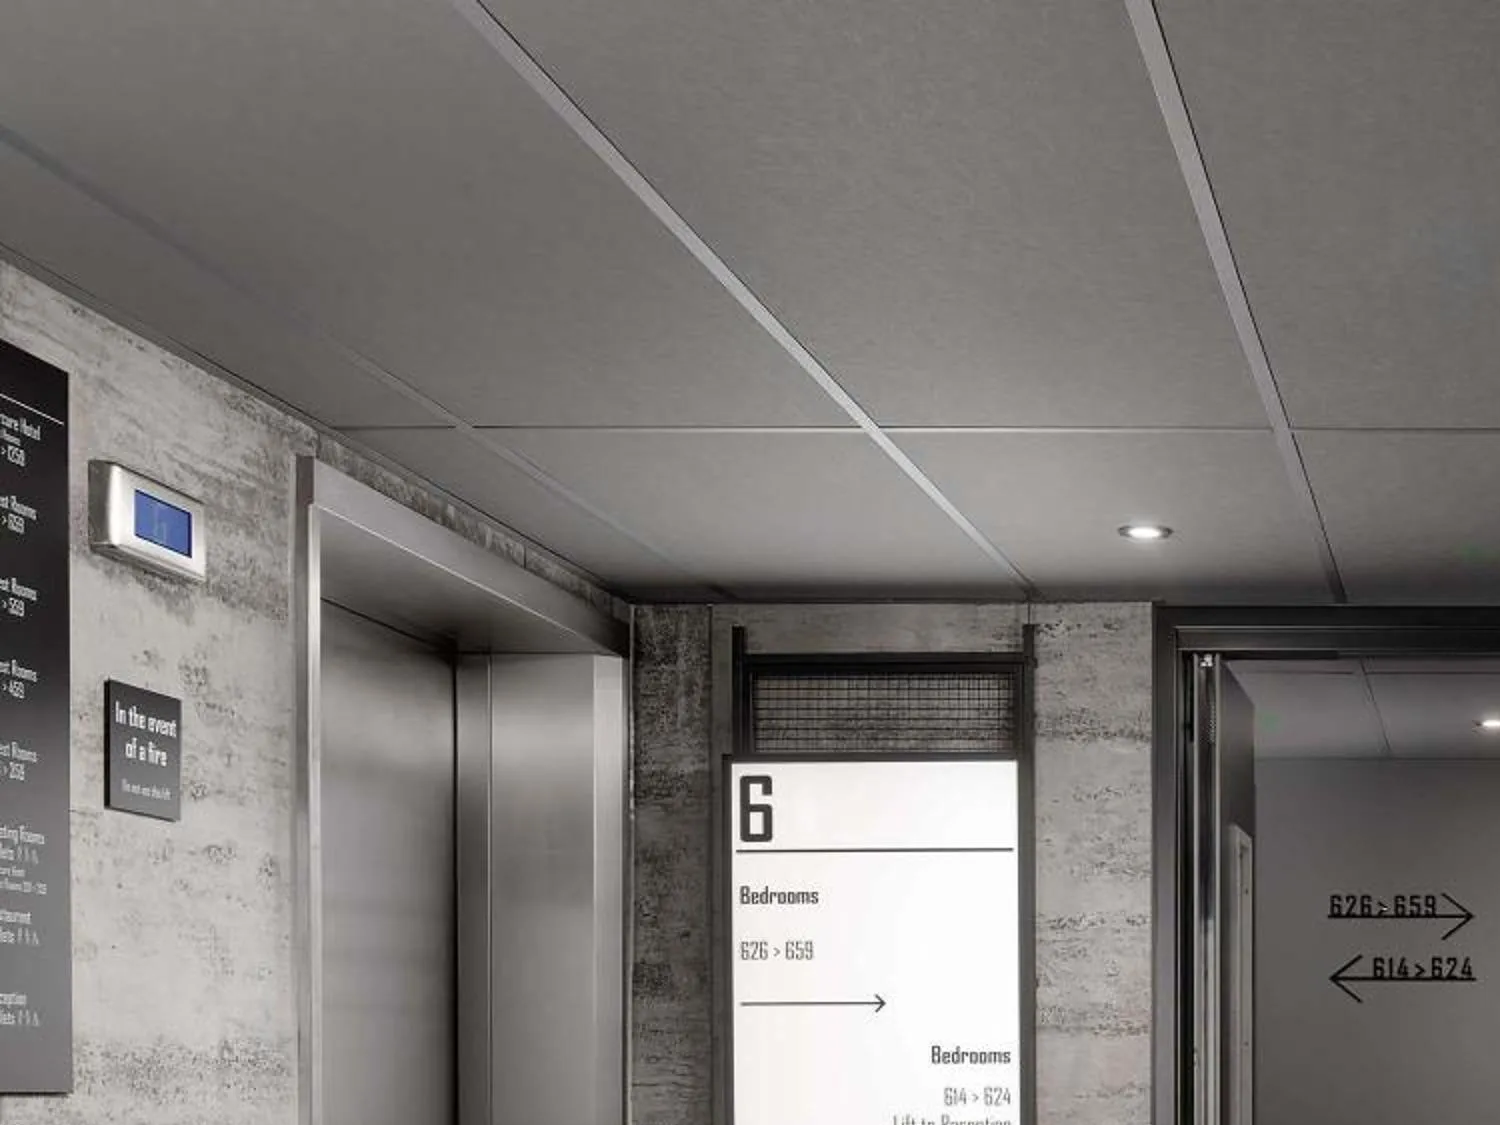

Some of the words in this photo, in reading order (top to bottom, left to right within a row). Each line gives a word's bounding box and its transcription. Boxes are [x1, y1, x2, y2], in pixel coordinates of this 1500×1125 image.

[115, 700, 126, 724] In
[128, 706, 146, 730] the
[148, 717, 177, 738] event
[125, 737, 137, 759] of
[139, 745, 146, 761] a
[148, 741, 167, 767] fire
[739, 775, 773, 843] 6
[739, 885, 819, 905] Bedrooms
[740, 940, 769, 960] 626
[785, 940, 814, 960] 659
[931, 1045, 1011, 1064] Bedrooms
[943, 1087, 967, 1106] 614
[983, 1087, 1011, 1106] 624
